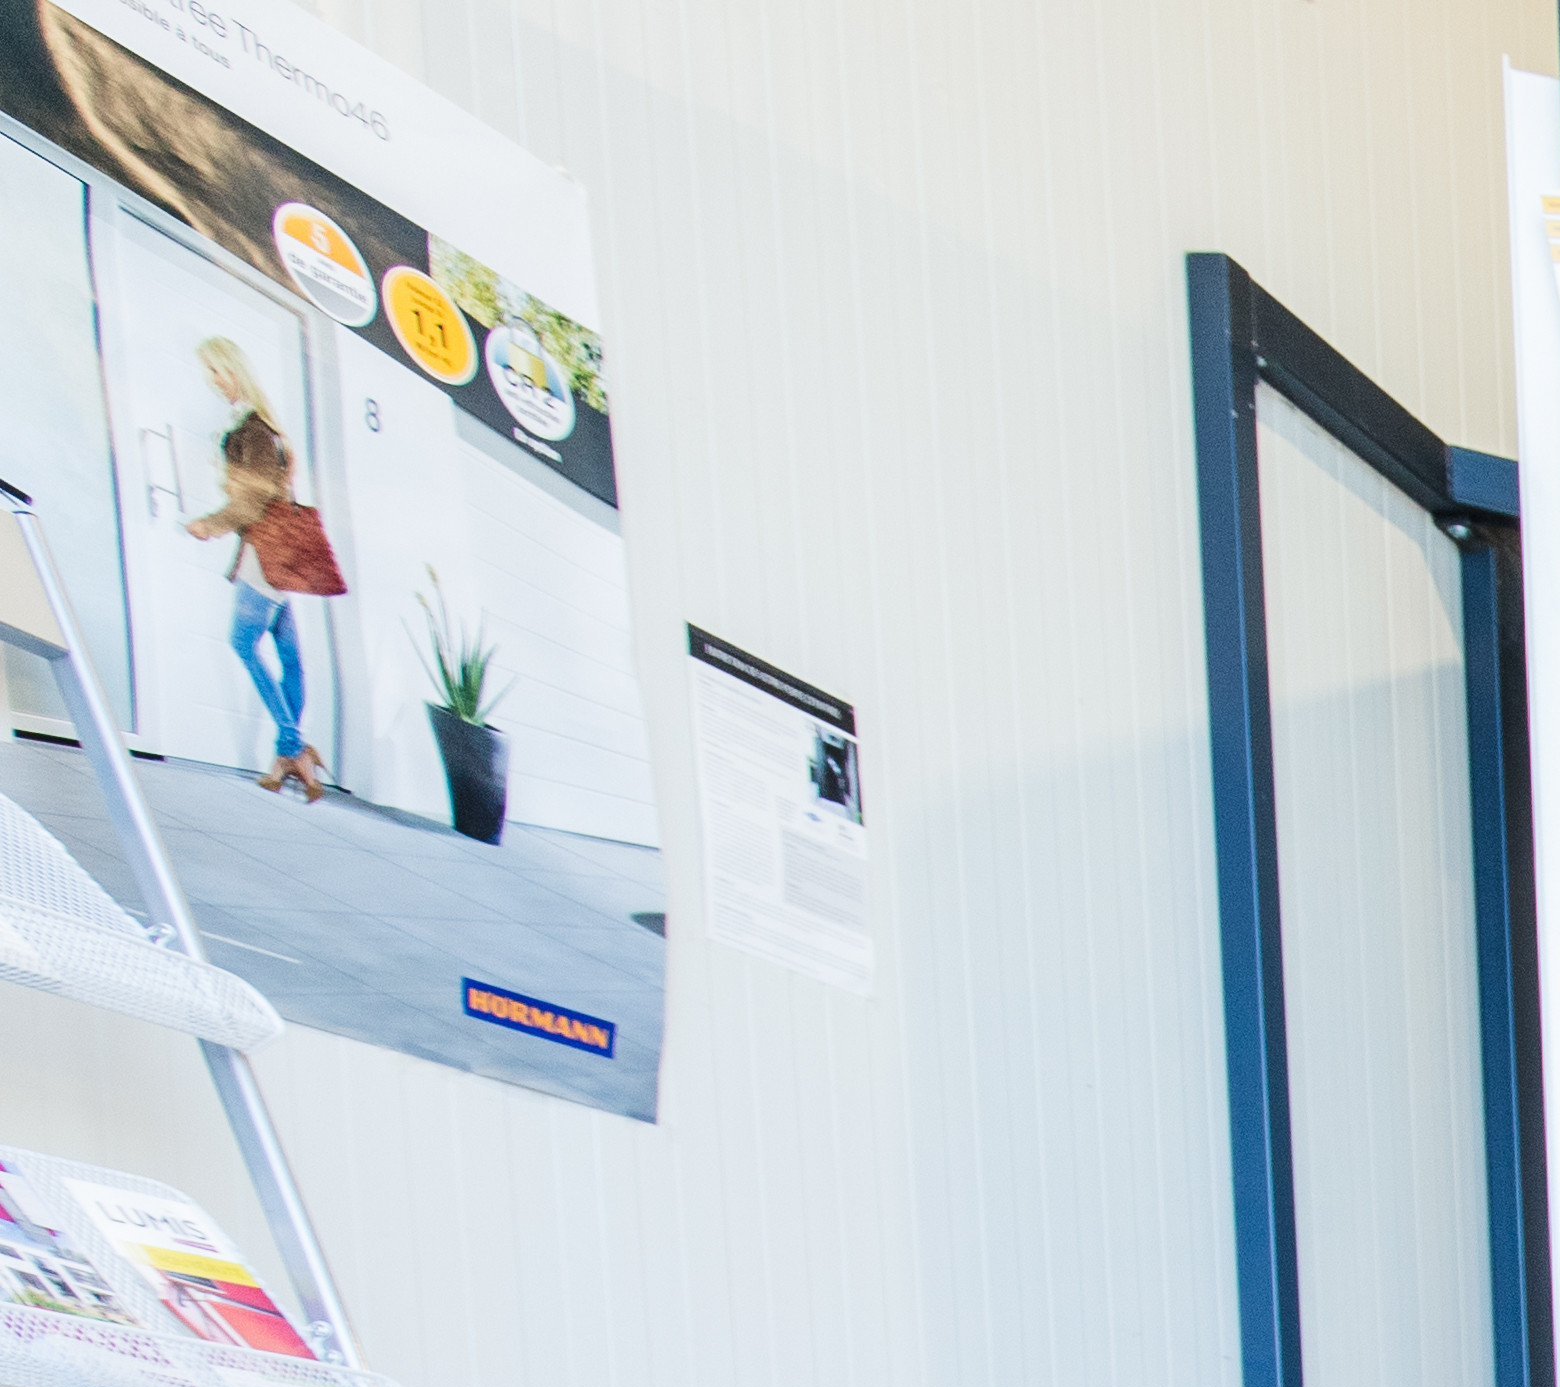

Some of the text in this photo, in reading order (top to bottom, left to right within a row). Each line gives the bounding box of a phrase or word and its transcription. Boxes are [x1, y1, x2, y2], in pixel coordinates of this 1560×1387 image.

[191, 38, 232, 70] tous
[232, 18, 391, 142] Thermo46
[366, 398, 382, 433] 8
